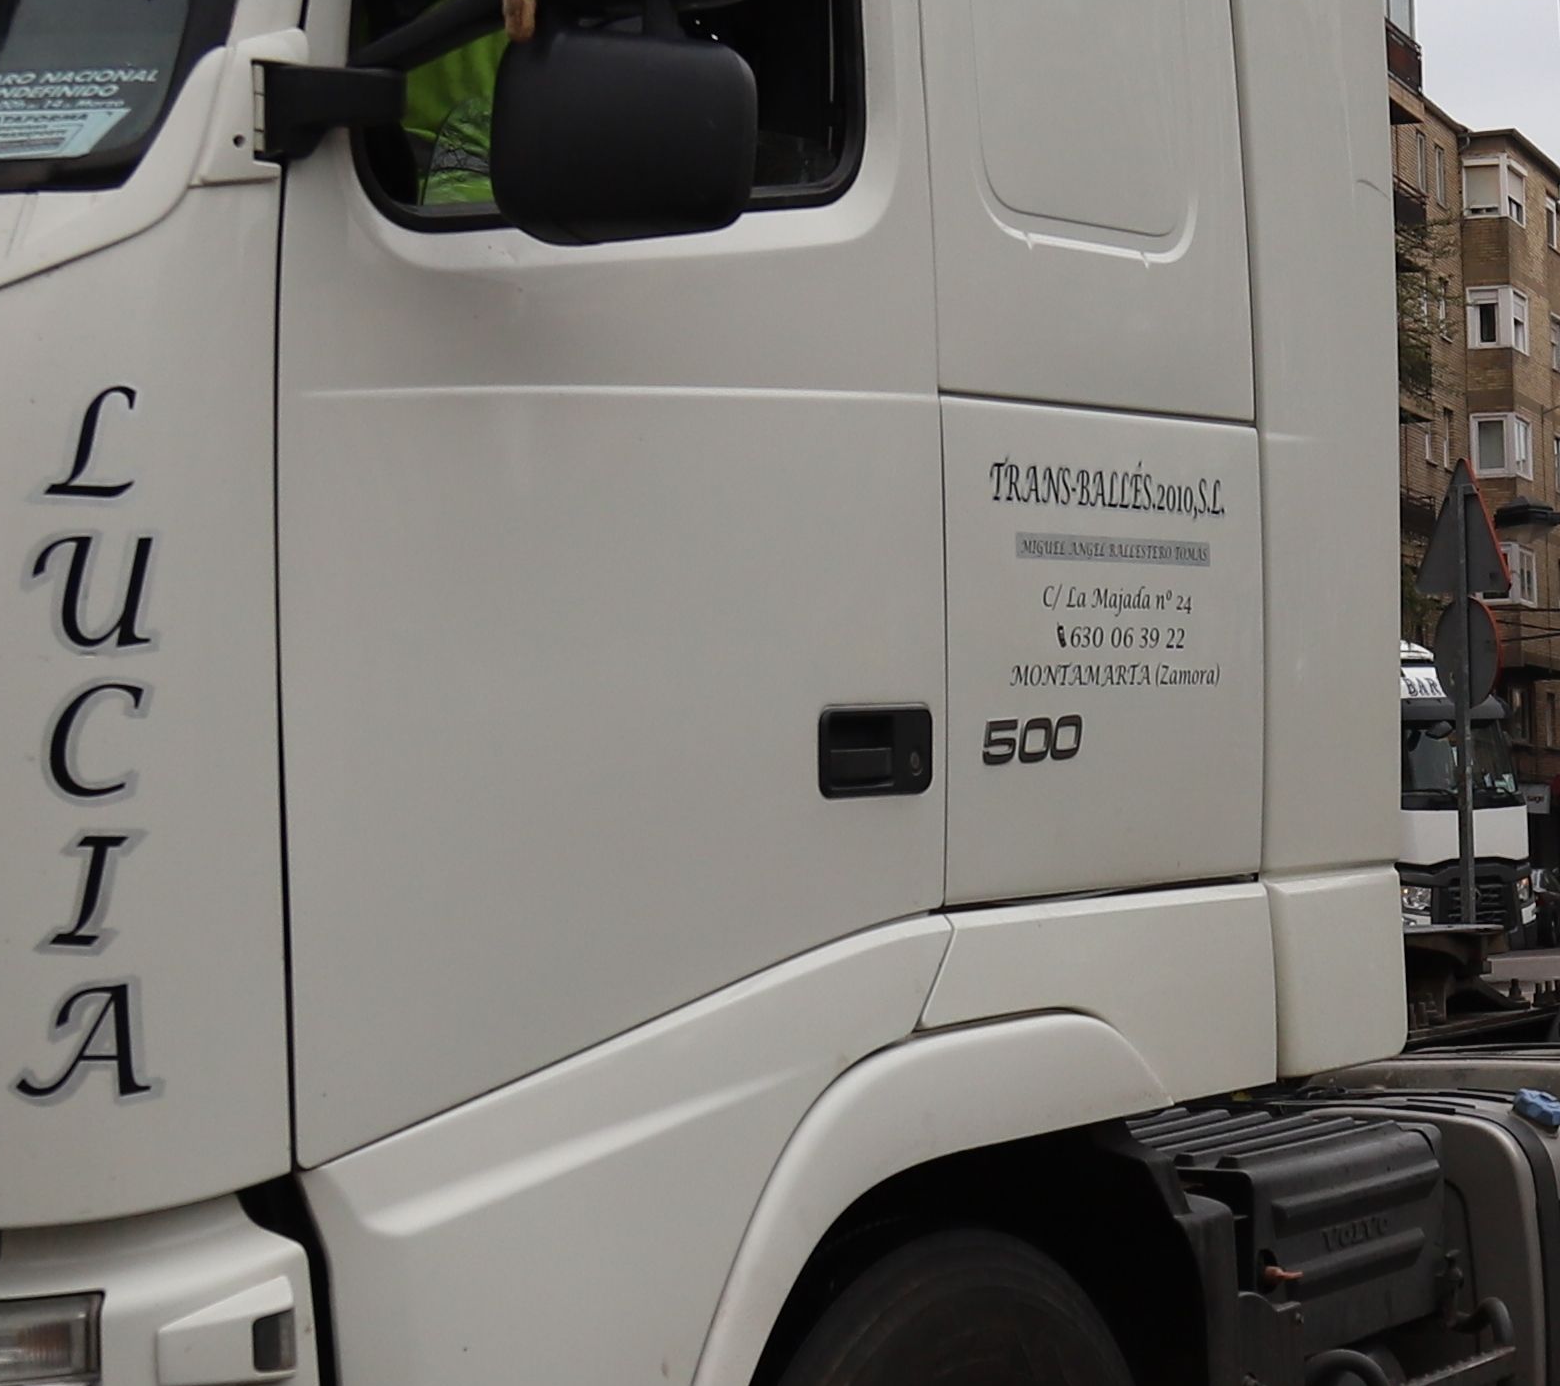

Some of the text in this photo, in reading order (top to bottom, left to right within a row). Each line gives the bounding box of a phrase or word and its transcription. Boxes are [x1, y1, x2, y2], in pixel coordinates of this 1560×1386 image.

[40, 68, 159, 83] NACIONAL
[1020, 539, 1066, 558] MIGUEL
[1108, 542, 1173, 561] BALLESTERO
[1042, 584, 1062, 611] C/
[1066, 585, 1086, 609] La
[1092, 585, 1151, 617] Majada
[1176, 594, 1192, 614] 24
[1069, 625, 1186, 650] 630 06 39 22
[1010, 660, 1221, 688] MONTAMARTA (Zamora)
[15, 384, 154, 1098] LUCIA
[982, 715, 1083, 765] 500
